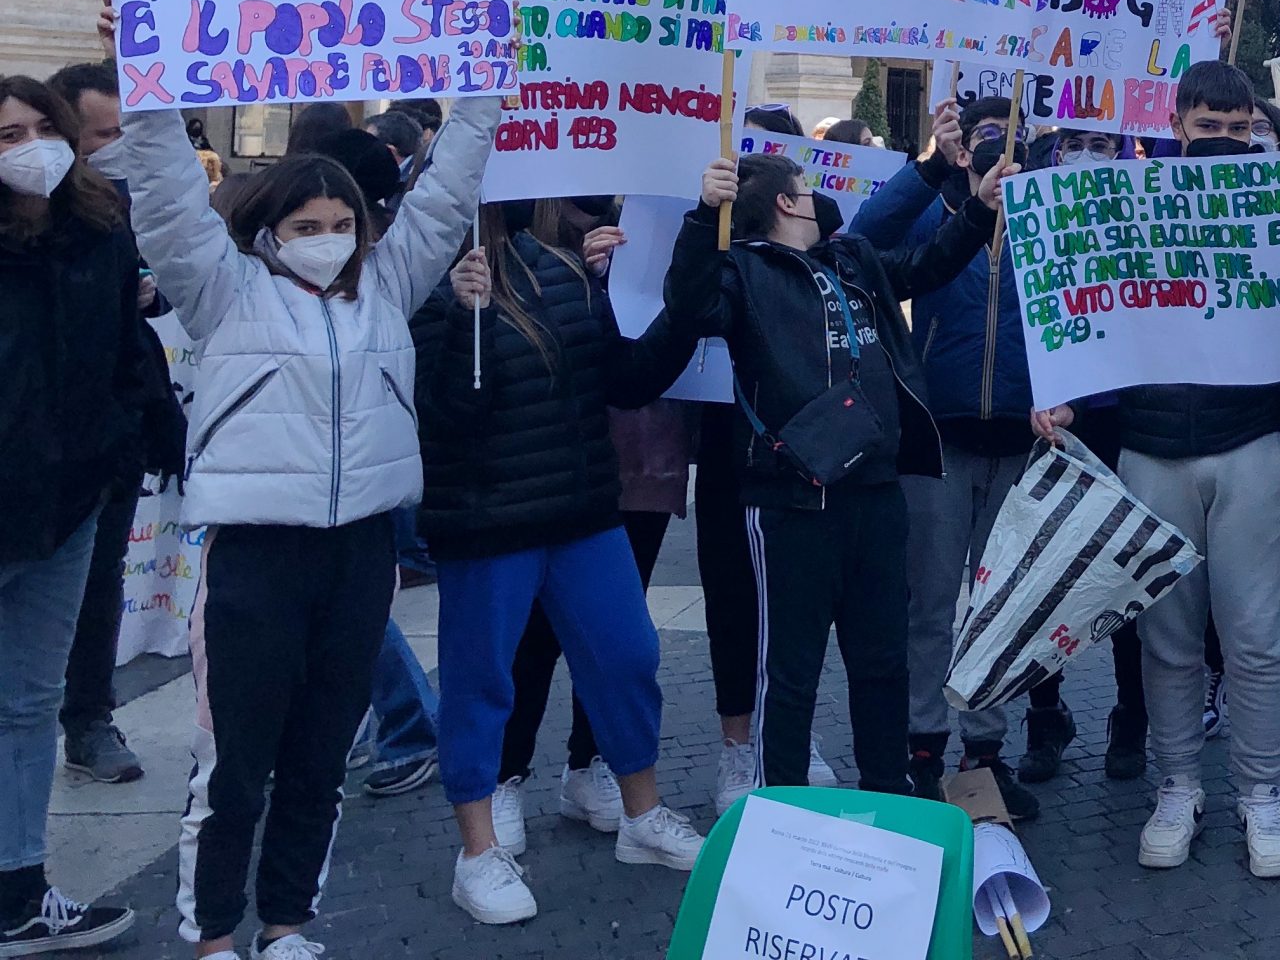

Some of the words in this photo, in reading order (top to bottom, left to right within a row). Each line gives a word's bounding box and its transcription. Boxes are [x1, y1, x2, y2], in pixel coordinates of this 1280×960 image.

[459, 41, 481, 58] 10
[556, 8, 651, 43] QUANDO
[659, 14, 681, 46] SI
[728, 13, 762, 41] PER
[123, 62, 175, 106] X
[181, 53, 349, 102] SALVATORE
[360, 53, 450, 92] FEUDALE
[457, 61, 517, 91] 1973
[1147, 39, 1190, 78] LA
[1057, 75, 1115, 120] ALLA
[567, 116, 616, 150] 1993
[1005, 177, 1043, 215] LA
[1051, 167, 1134, 202] MAFIA
[1172, 163, 1205, 191] UN
[1008, 216, 1040, 242] NO
[1046, 195, 1149, 232] UMANO:
[1153, 193, 1191, 220] HA
[1198, 193, 1228, 219] UN
[1012, 237, 1045, 269] PIO
[1054, 233, 1101, 258] UNA
[1104, 224, 1146, 250] SUA
[1150, 222, 1256, 248] EVOLUZIONE
[1084, 252, 1155, 283] ANCHE
[1165, 251, 1209, 278] UNA
[1027, 295, 1060, 327] PER
[1064, 284, 1114, 315] VITO
[1216, 280, 1232, 309] 3
[786, 884, 873, 930] POSTO
